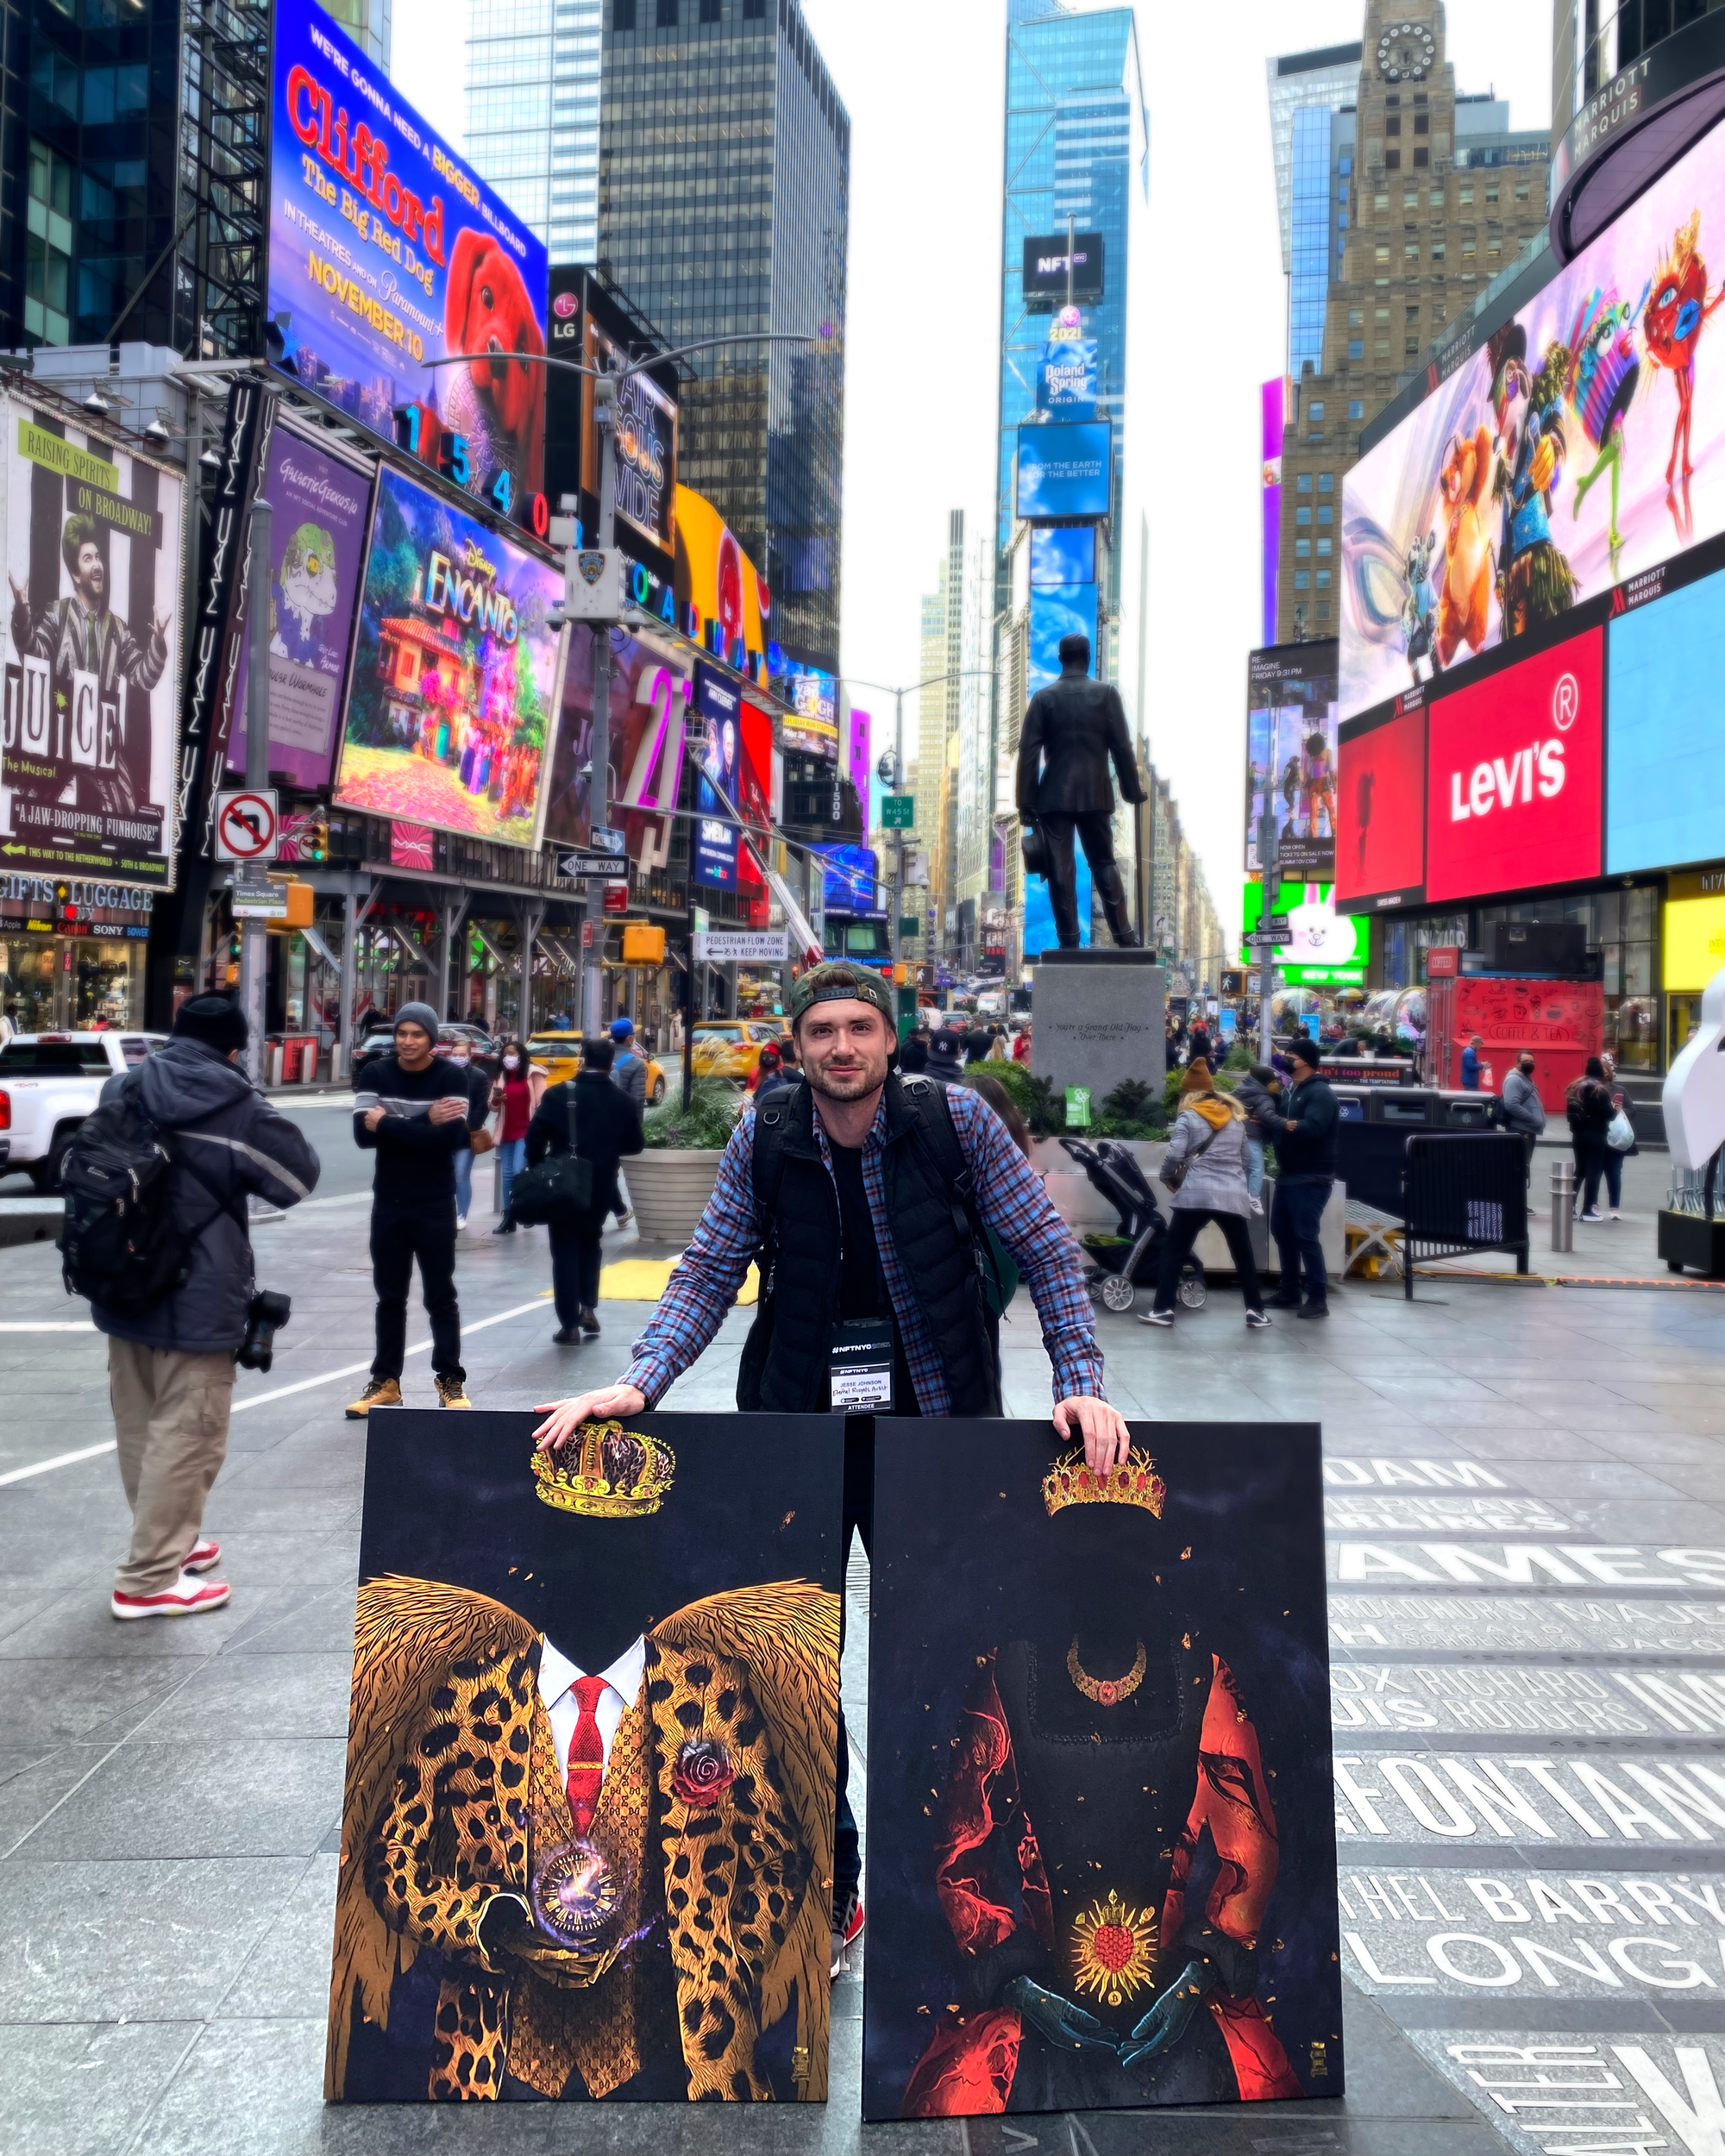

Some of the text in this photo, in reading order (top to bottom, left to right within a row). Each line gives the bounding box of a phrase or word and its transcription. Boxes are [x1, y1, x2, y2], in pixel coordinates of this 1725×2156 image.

[1574, 57, 1652, 137] MARRIOTT
[1574, 93, 1640, 162] MARQUIS
[310, 23, 526, 257] WE'RE GONNA NEED A BIGGER BILLBOARD
[287, 65, 446, 268] Clifford
[303, 154, 434, 298] The Big Red Dog
[285, 199, 296, 224] IN
[299, 209, 351, 267] THEATRES
[353, 263, 367, 280] AND
[379, 270, 444, 338] Paramount+
[308, 250, 405, 350] NOVEMBER
[406, 329, 424, 362] 10
[555, 323, 575, 338] LG
[1049, 327, 1082, 342] 2021
[1442, 325, 1476, 365] MARRIOTT
[1045, 363, 1085, 384] Poland
[1442, 345, 1471, 379] MARQUIS
[1051, 376, 1088, 395] Spring
[28, 429, 110, 489] RAISING SPIRITS
[1067, 468, 1100, 477] BETTER
[78, 486, 152, 536] ON BROADWAY!
[1628, 566, 1666, 592] MARRIOTT
[426, 550, 518, 644] ENCANTO
[1628, 582, 1662, 606] MARQUIS
[1251, 661, 1280, 671] IMAGINE
[1251, 671, 1275, 680] FRIDAY
[288, 672, 327, 697] WORMHOLE
[1403, 686, 1425, 702] MARRIOTT
[1403, 697, 1423, 711] MARQUIS
[2, 756, 56, 778] The Musical
[832, 782, 841, 820] 1500
[28, 805, 103, 834] JAW-DROPPING
[595, 834, 619, 848] ONE WAY
[29, 847, 41, 858] THIS
[42, 848, 55, 860] WAY
[56, 850, 64, 861] TO
[65, 850, 74, 862] THE
[75, 852, 112, 866] NETHERWORLD
[139, 862, 166, 873] BROADWAY
[568, 862, 620, 872] ONE WAY
[70, 881, 154, 912] LUGGAGE
[3, 919, 150, 937] Apple Nikon Canon SONY BOWER
[706, 937, 784, 945] PEDESTRIAN FLOW ZONE
[740, 948, 784, 956] KEEP MOVING
[1302, 970, 1363, 981] NEW YORK
[1056, 1023, 1076, 1033] You're
[1085, 1024, 1107, 1032] Grand
[1125, 1023, 1141, 1033] Flag
[1496, 1026, 1562, 1041] COFFEE & TEA
[1342, 1069, 1400, 1078] too proud
[1328, 1599, 1546, 1621] ROADHURST
[1412, 1668, 1609, 1698] RICHARD
[1440, 1699, 1649, 1733] RODGERS
